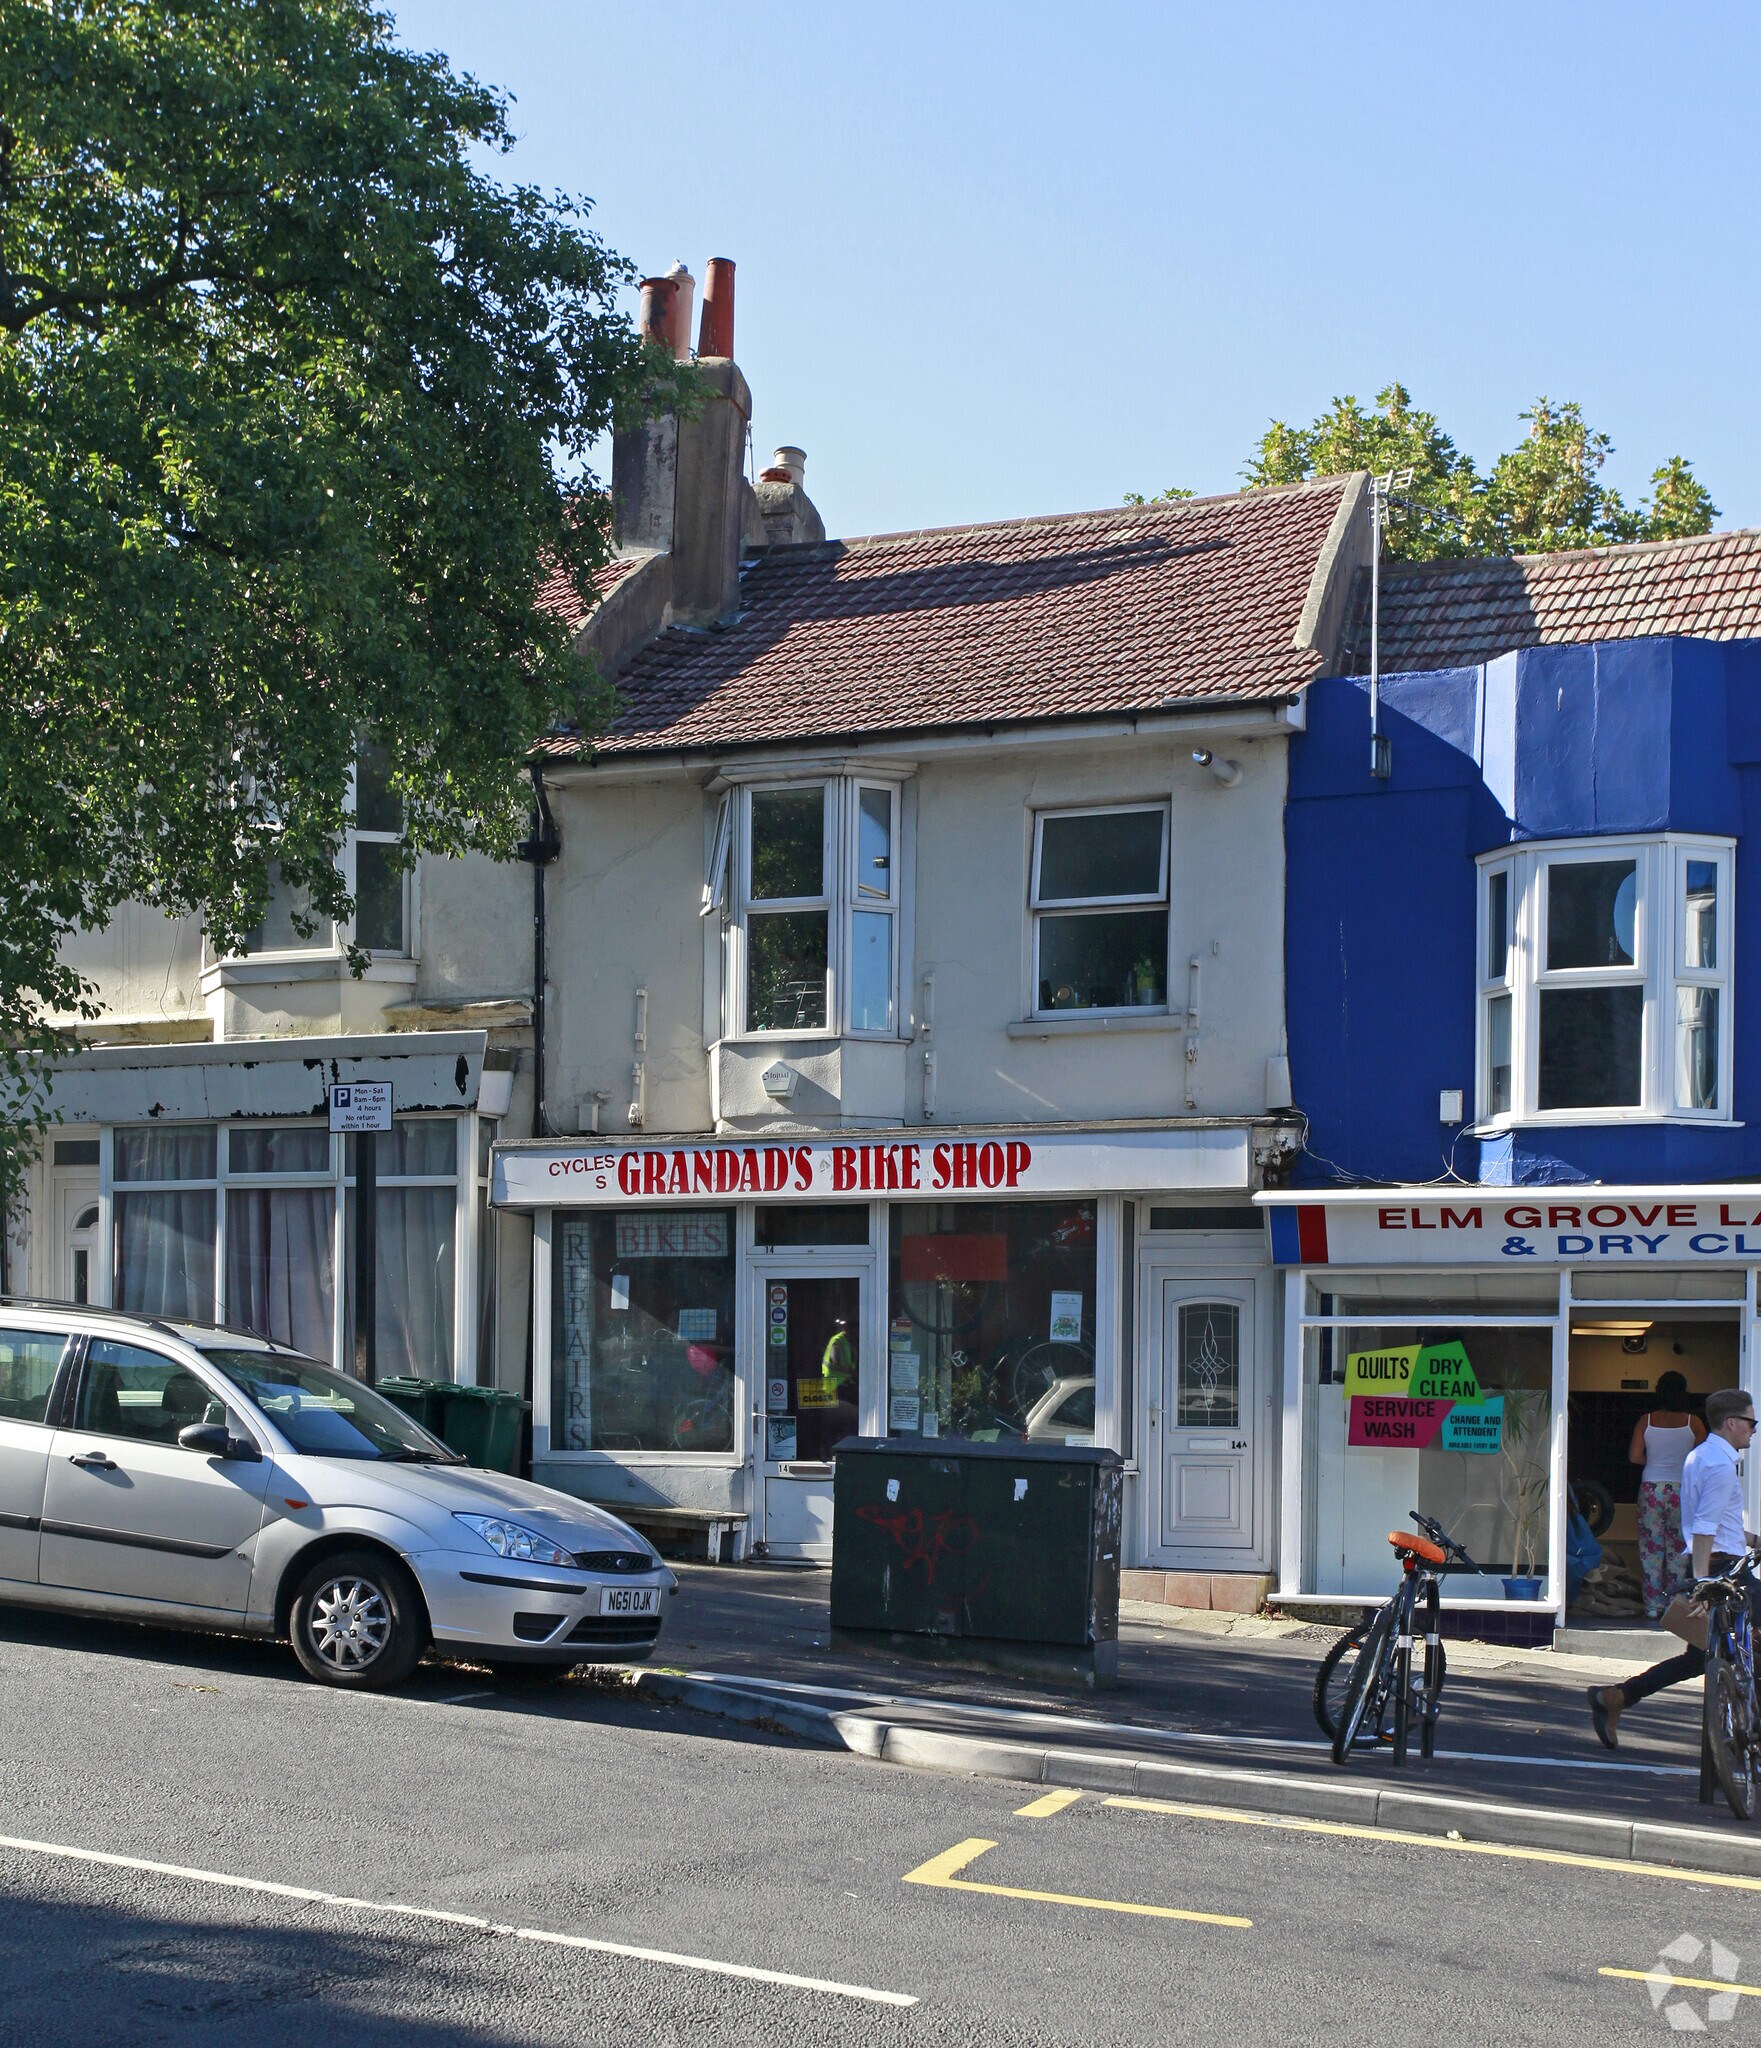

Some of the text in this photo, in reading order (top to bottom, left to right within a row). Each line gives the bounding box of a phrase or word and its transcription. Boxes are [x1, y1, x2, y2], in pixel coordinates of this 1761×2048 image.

[548, 1154, 616, 1177] CYCLES
[617, 1141, 1032, 1196] GRANDAD'S BIKE SHOP
[595, 1175, 607, 1190] S
[1378, 1207, 1482, 1229] ELM
[1504, 1204, 1697, 1229] GROVE
[619, 1223, 722, 1253] BIKES
[1501, 1236, 1537, 1256] &
[1557, 1234, 1670, 1255] DRY
[765, 1246, 774, 1254] 14
[567, 1233, 588, 1451] REPAIRS
[1357, 1356, 1409, 1380] QUILTS
[1429, 1358, 1463, 1375] DRY
[1419, 1380, 1475, 1397] CLEAN
[1364, 1401, 1436, 1417] SERVICE
[1450, 1415, 1501, 1425] CHANGE AND
[1364, 1422, 1415, 1438] WASH
[1453, 1427, 1498, 1437] ATTENDENT
[779, 1464, 788, 1473] 14
